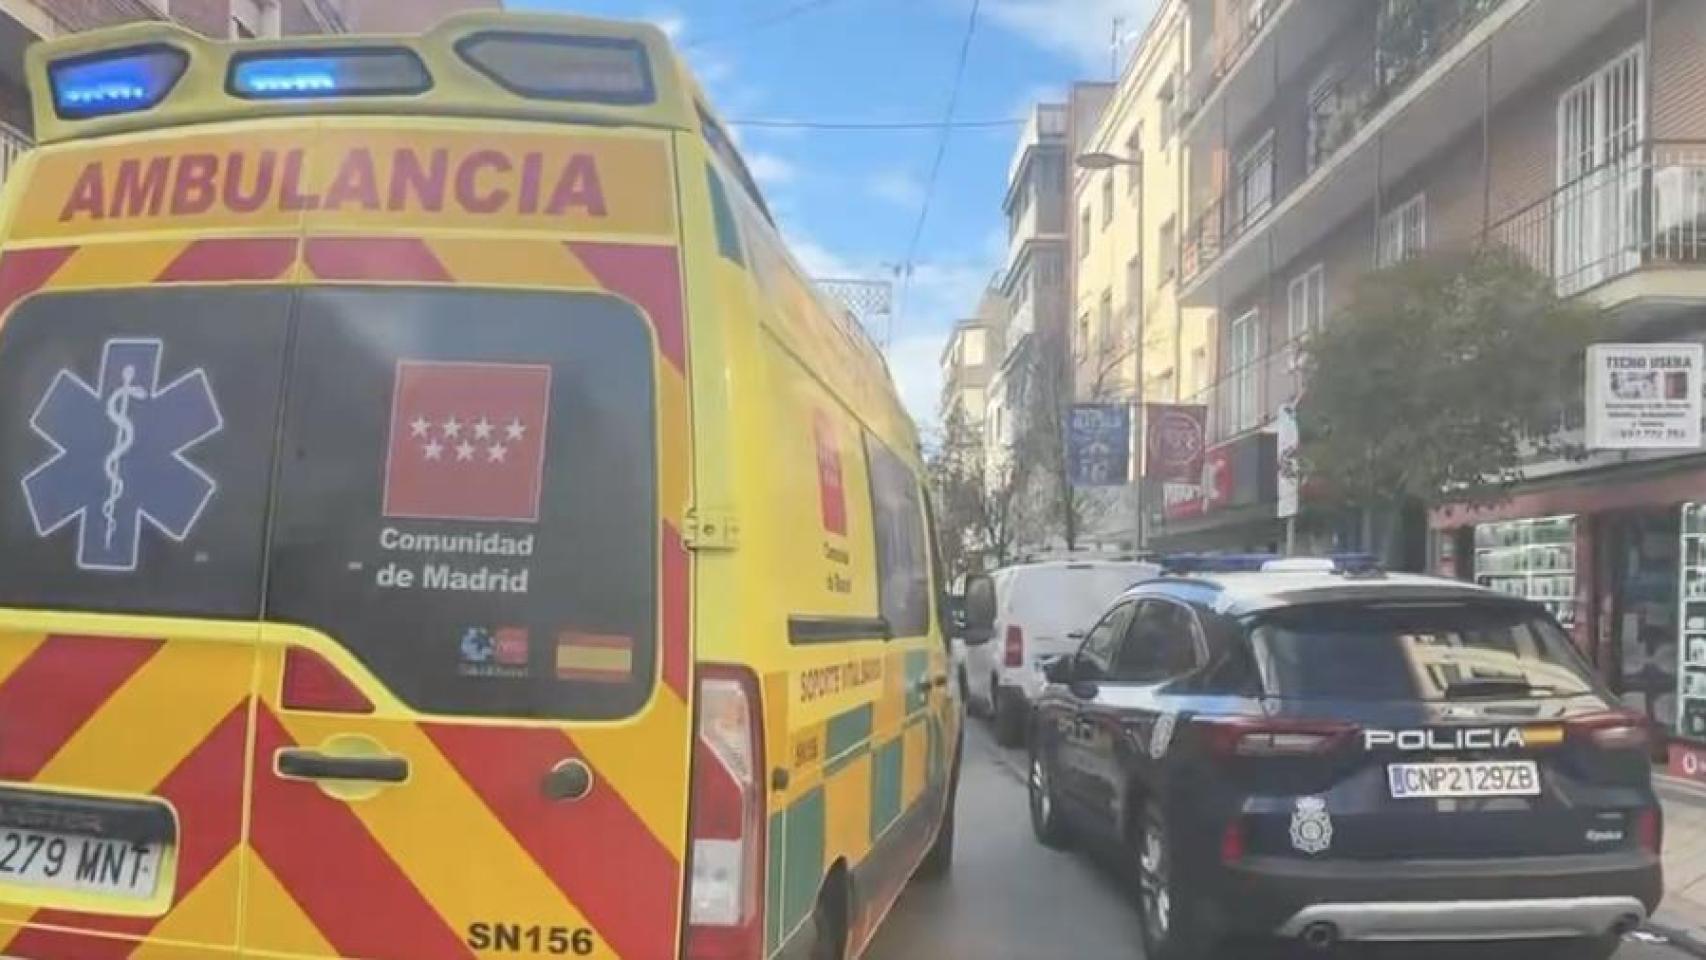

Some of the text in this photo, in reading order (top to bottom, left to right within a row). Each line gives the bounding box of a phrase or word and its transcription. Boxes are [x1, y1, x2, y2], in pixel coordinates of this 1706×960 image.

[58, 147, 608, 222] AMBULANCIA
[379, 526, 535, 556] Comunidad
[375, 562, 529, 594] de Madrid
[1363, 726, 1526, 750] POLICIA
[1404, 765, 1535, 792] CNP2129ZB
[75, 839, 149, 888] MNT
[468, 922, 593, 956] SN156
